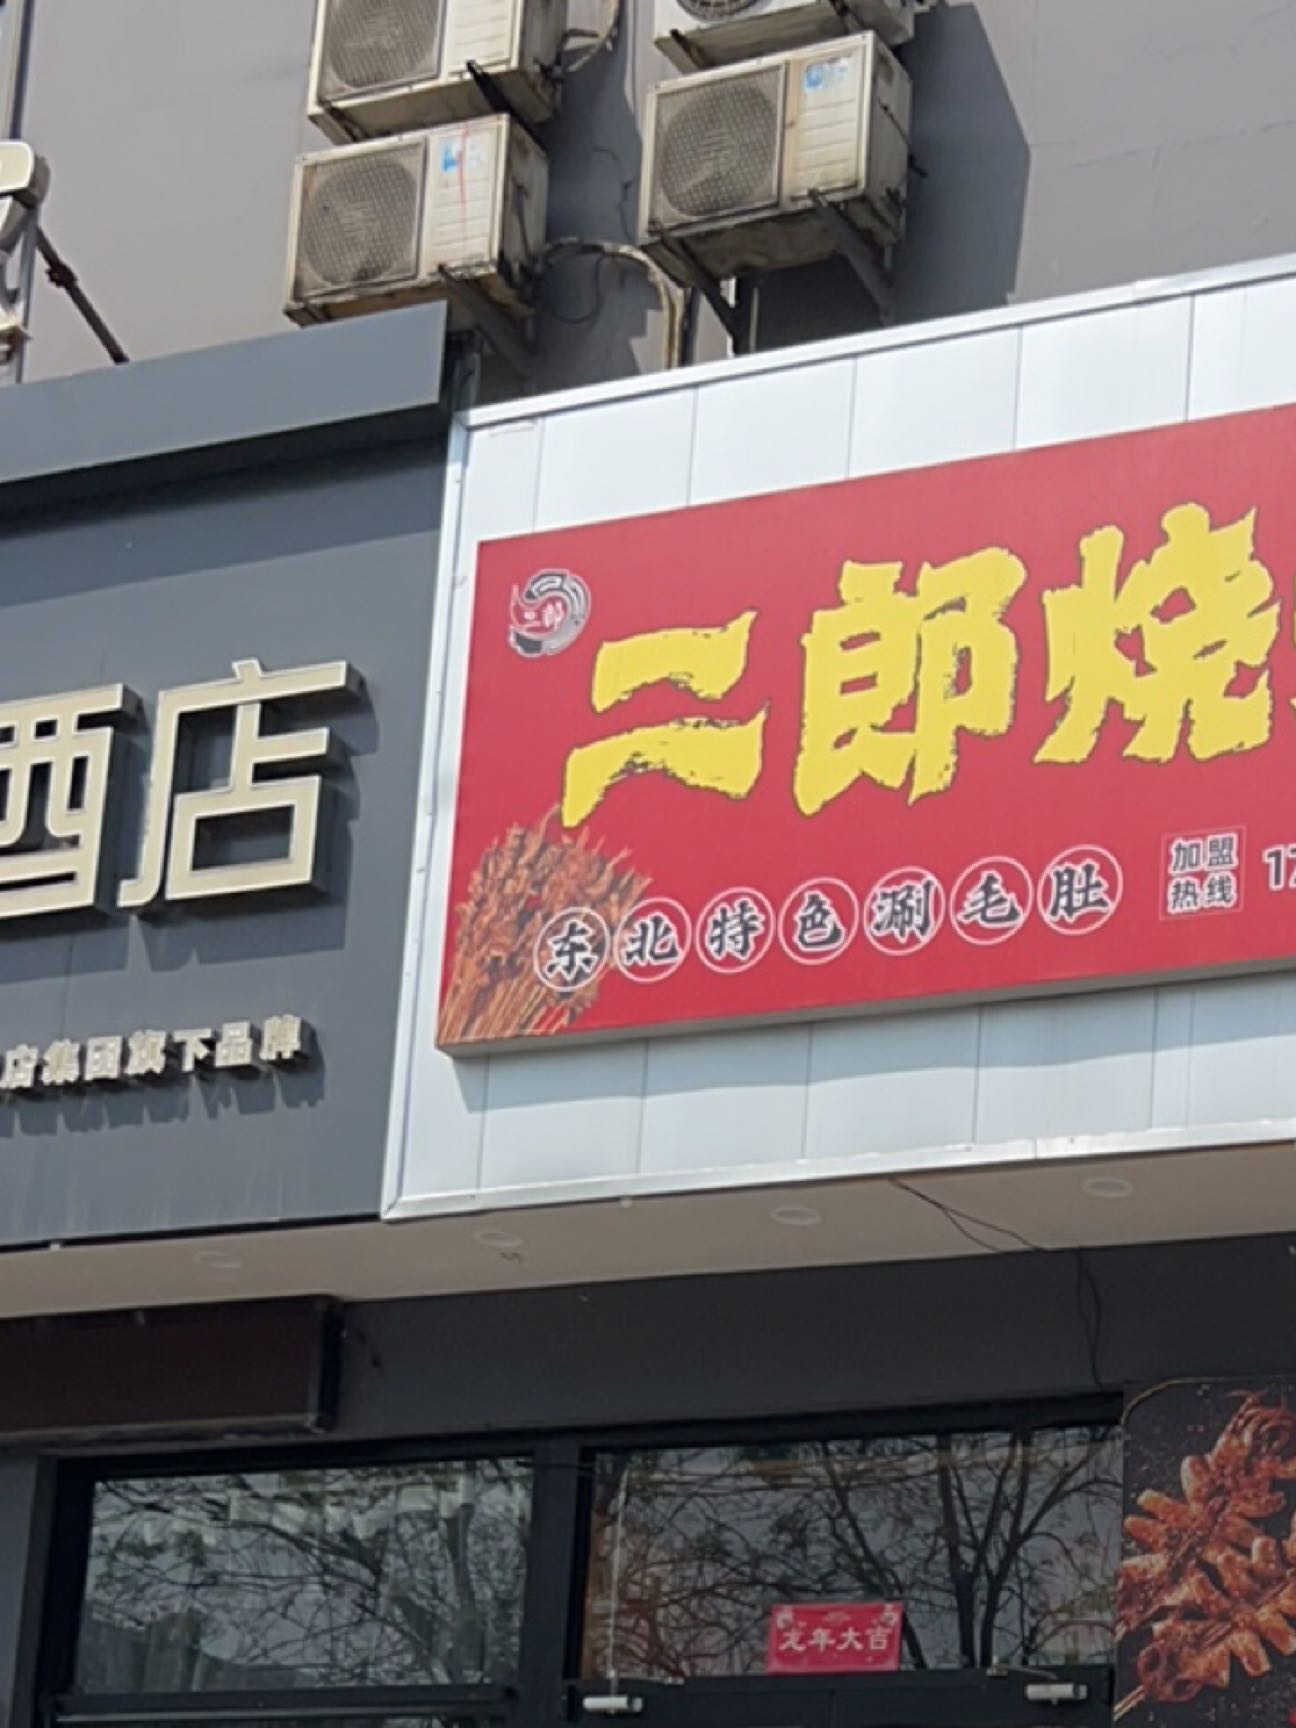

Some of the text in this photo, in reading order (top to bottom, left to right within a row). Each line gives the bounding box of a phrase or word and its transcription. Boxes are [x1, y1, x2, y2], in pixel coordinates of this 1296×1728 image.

[1170, 833, 1239, 874] 加盟
[1168, 874, 1239, 914] 热线
[546, 861, 1109, 980] 东北特色涮毛肚
